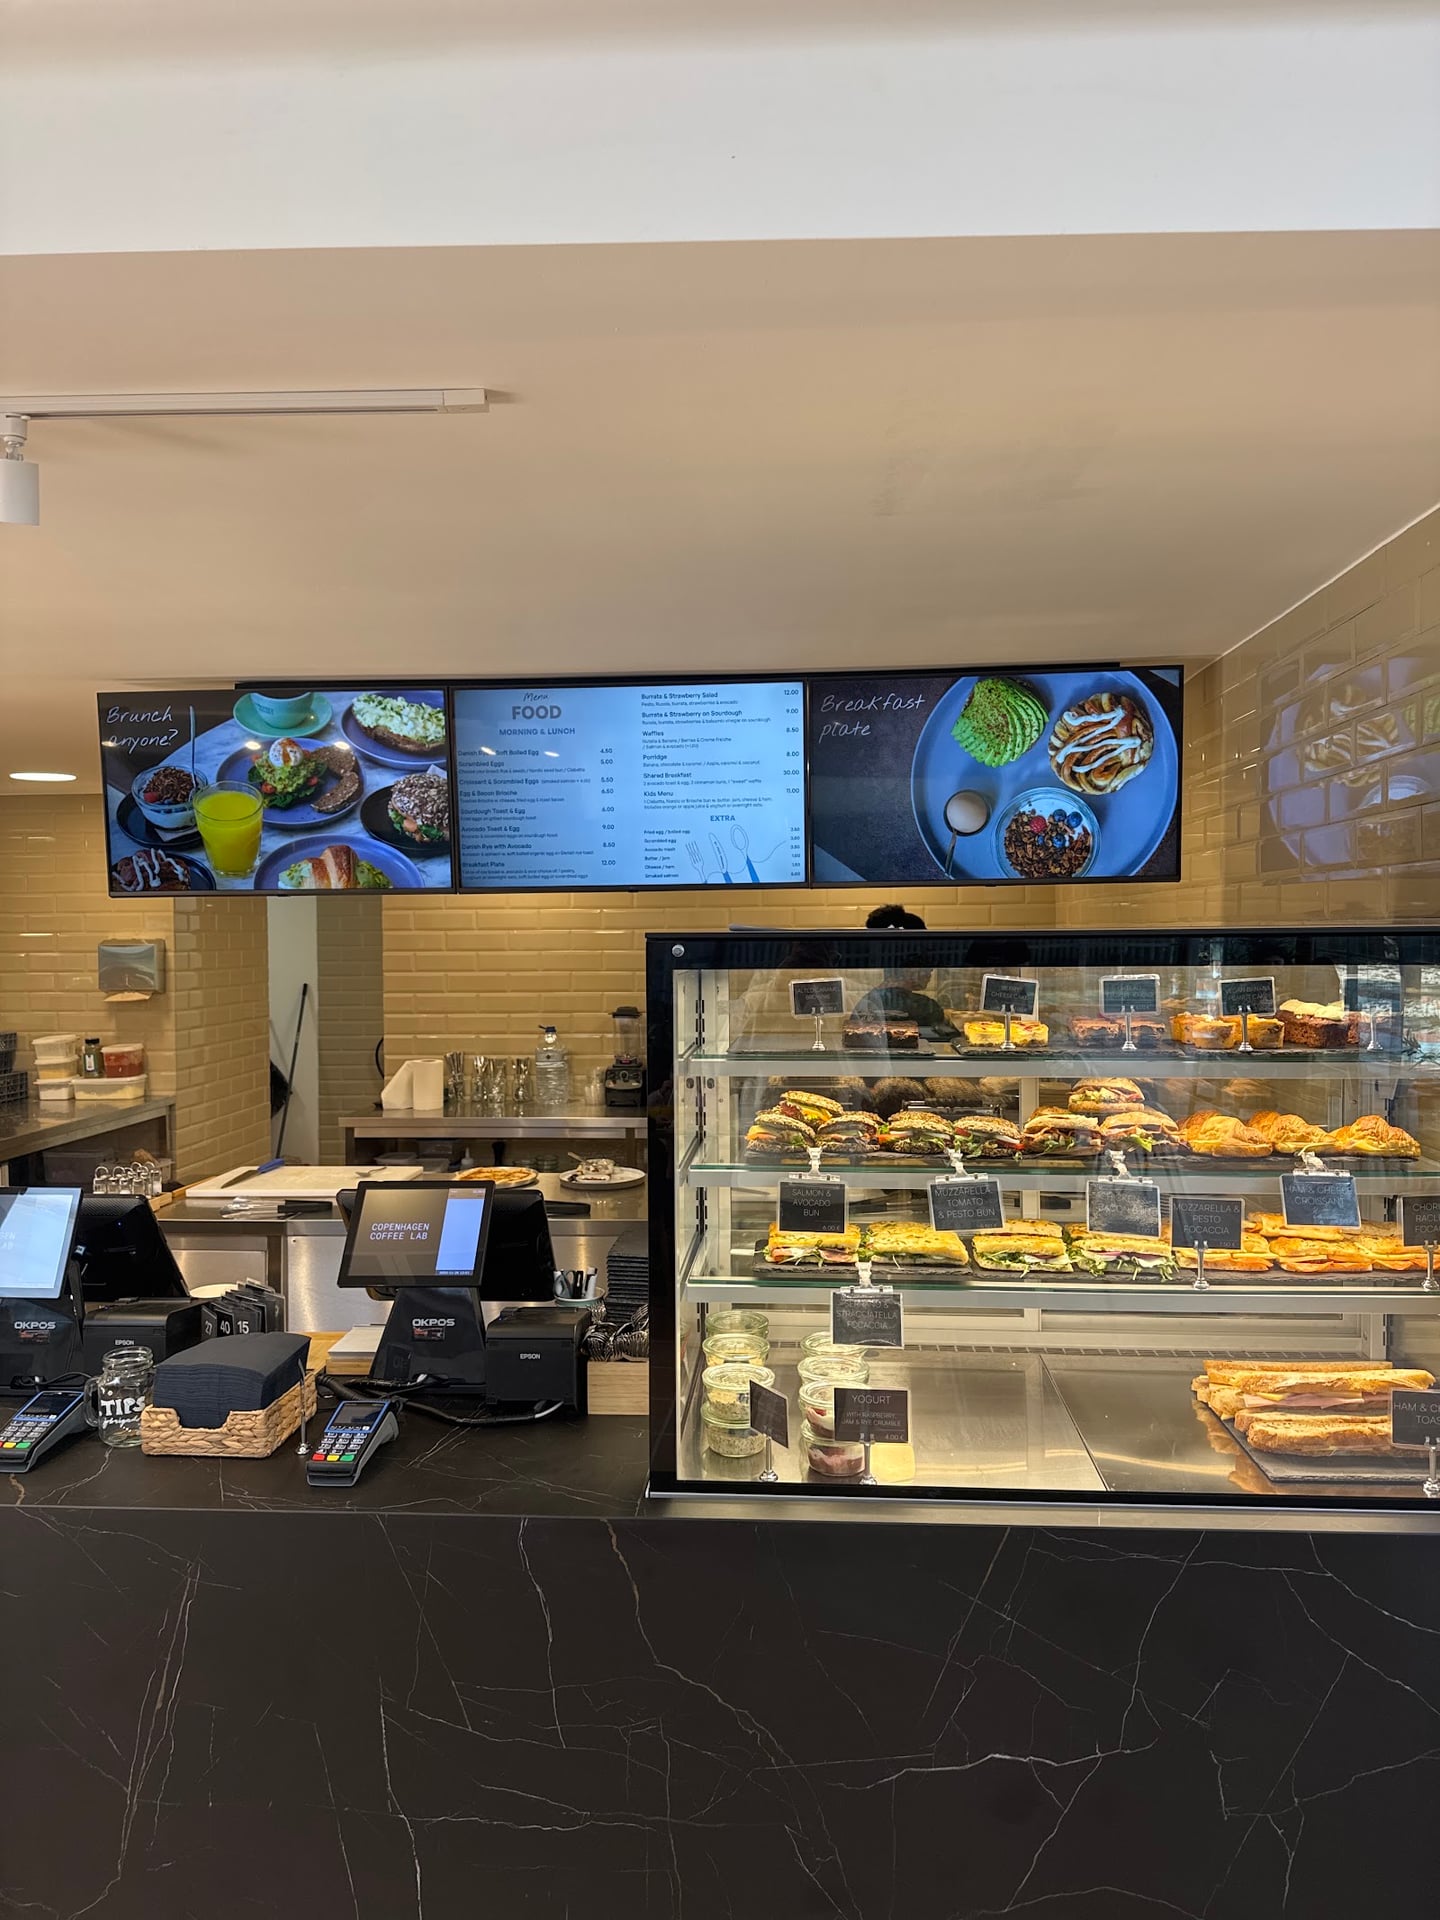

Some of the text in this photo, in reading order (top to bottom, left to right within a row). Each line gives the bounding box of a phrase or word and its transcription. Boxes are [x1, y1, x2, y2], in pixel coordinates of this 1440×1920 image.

[523, 692, 549, 701] Menu
[821, 693, 925, 712] Breakfast
[107, 705, 173, 723] Brunch
[512, 705, 561, 720] FOOD
[499, 728, 538, 736] MORNING
[819, 721, 871, 744] plate
[106, 729, 178, 754] anyone?
[528, 749, 539, 757] Egg
[525, 778, 539, 786] Eggs
[792, 1189, 824, 1197] SALMON
[793, 1199, 831, 1207] AVOCADO
[947, 1198, 983, 1207] TOMATO
[1294, 1196, 1345, 1206] CROISSANT
[1174, 1203, 1240, 1213] MOZZARELLA &
[1412, 1202, 1440, 1211] CHOR
[938, 1208, 995, 1219] & PESTO BUN
[1415, 1214, 1440, 1222] RACL
[1192, 1214, 1221, 1223] PESTO
[371, 1223, 430, 1231] COPENHAGEN
[1183, 1225, 1229, 1234] FOCACCIA
[1415, 1225, 1440, 1233] FOCA
[370, 1232, 428, 1240] COFFEE LAB
[14, 1321, 56, 1330] OKPOS
[220, 1320, 231, 1334] 40
[412, 1318, 455, 1327] OKPOS
[847, 1321, 888, 1329] FOCACCIA
[205, 1320, 213, 1335] 27
[237, 1321, 249, 1334] 15
[852, 1395, 891, 1404] YOGURT
[100, 1396, 145, 1416] TIPS
[1394, 1402, 1417, 1412] HAM
[1420, 1404, 1427, 1412] &
